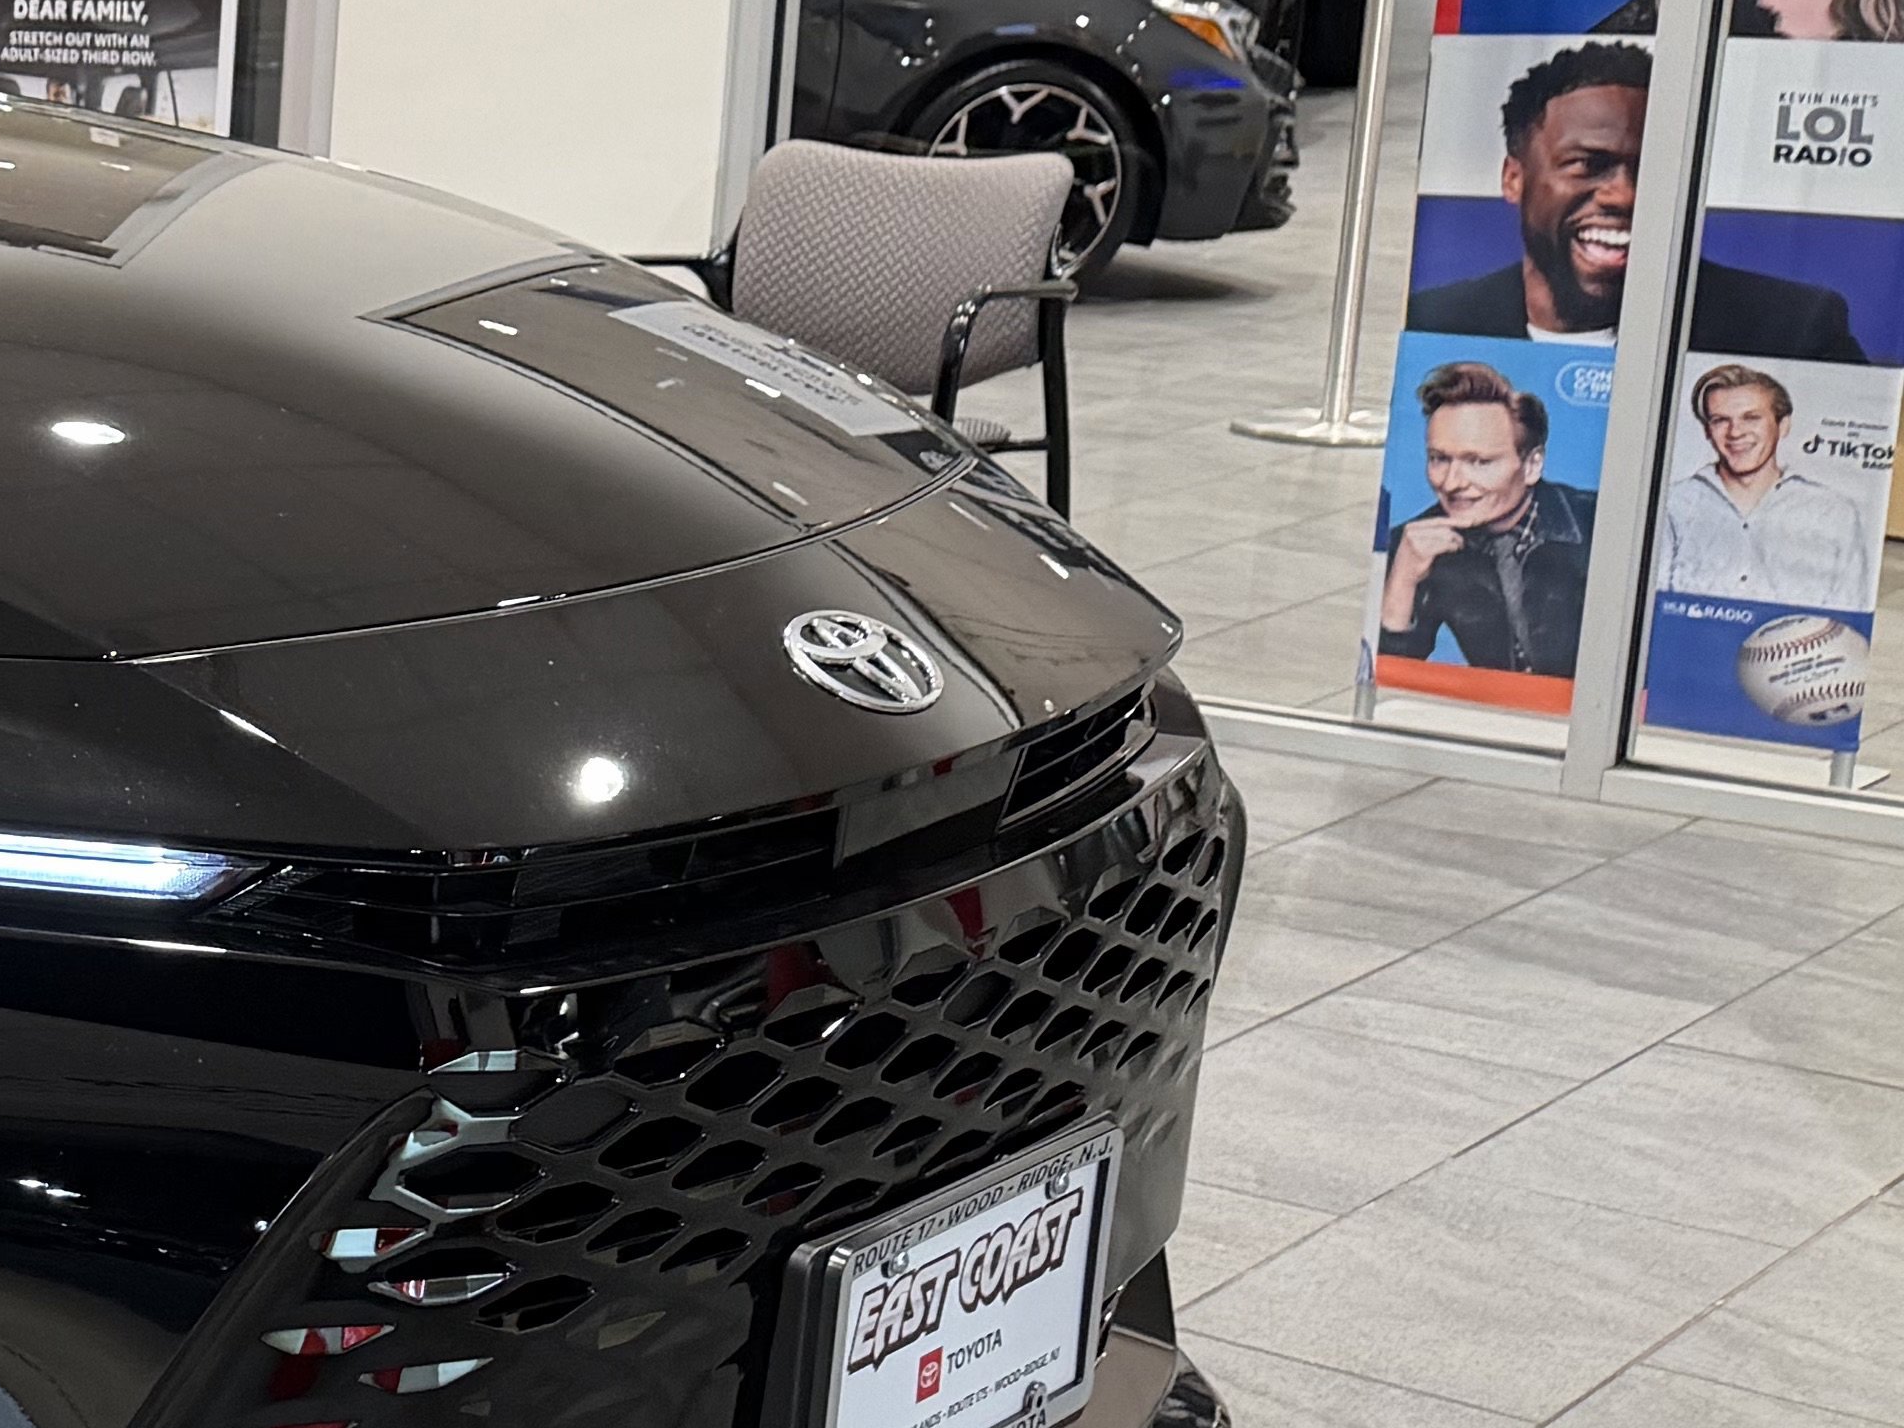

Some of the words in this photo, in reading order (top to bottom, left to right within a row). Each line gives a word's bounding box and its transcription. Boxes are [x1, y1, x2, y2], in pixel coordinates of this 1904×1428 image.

[72, 0, 149, 26] FAMILY,
[0, 47, 80, 63] ADULT-SIZED
[82, 49, 120, 64] THIRD
[9, 30, 62, 46] STRETCH
[65, 32, 91, 47] OUT
[94, 33, 127, 48] WITH
[130, 34, 149, 48] AN
[1775, 105, 1874, 145] LOL
[852, 1230, 913, 1276] ROUTE
[917, 1218, 933, 1241] 17
[947, 1185, 1003, 1227] WOOD
[1016, 1156, 1075, 1193] RIDGE,
[1078, 1135, 1114, 1165] N.J.
[847, 1247, 961, 1375] EAST
[958, 1186, 1084, 1313] COAST
[946, 1328, 1002, 1374] TOYOTA
